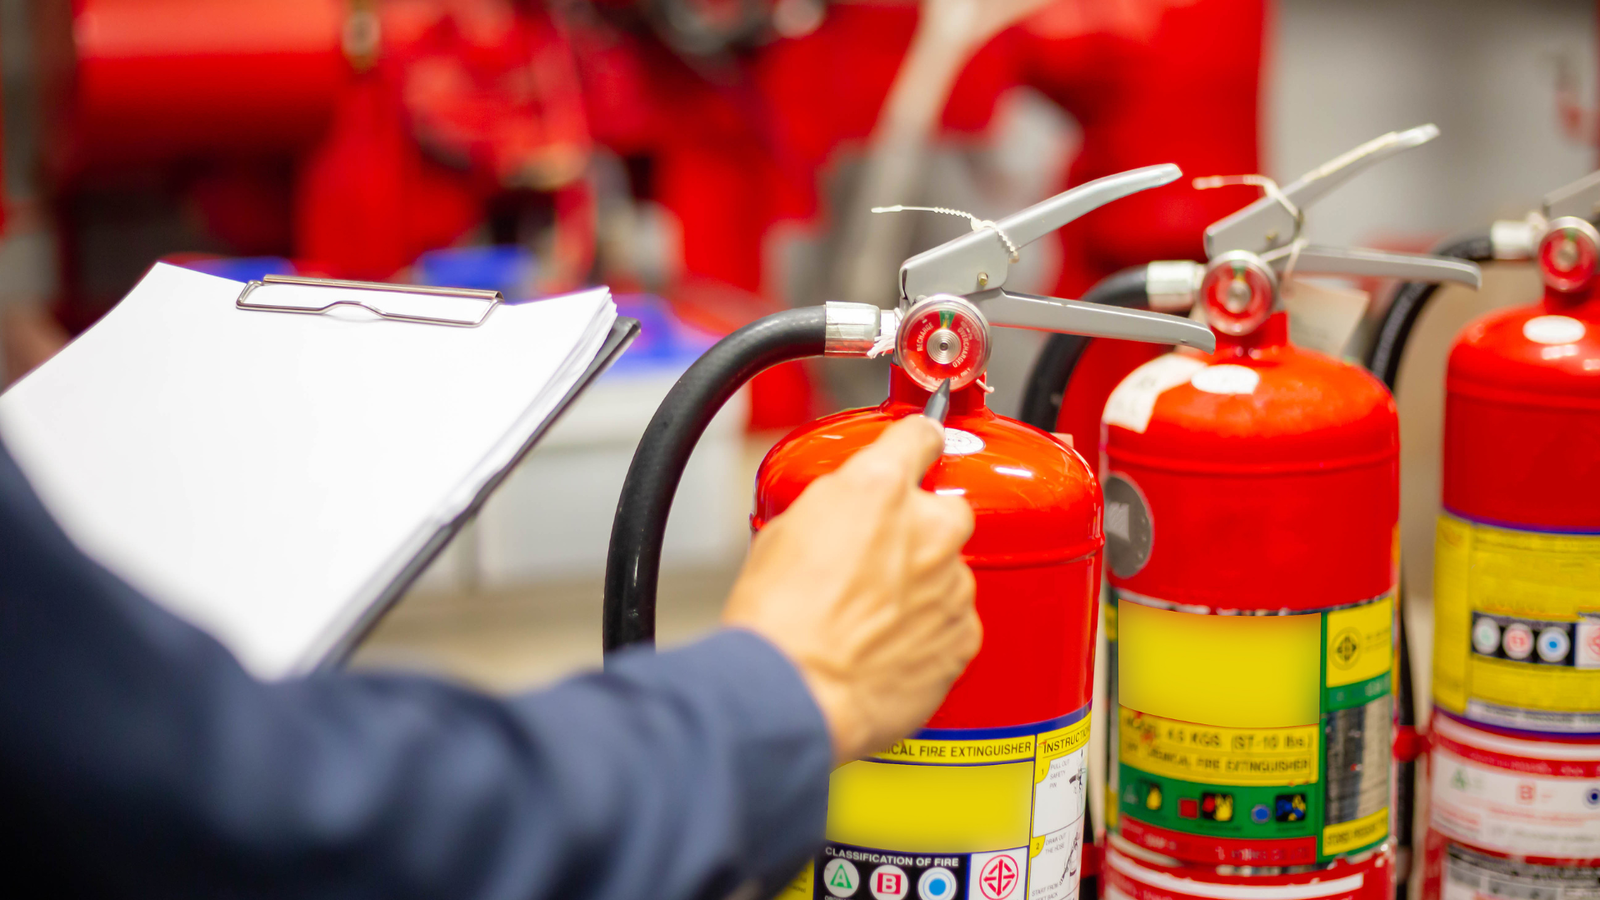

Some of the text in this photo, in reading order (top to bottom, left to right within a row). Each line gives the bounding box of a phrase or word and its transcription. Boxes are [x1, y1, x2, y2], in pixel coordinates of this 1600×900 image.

[919, 745, 946, 757] FIRE
[950, 741, 1032, 758] EXTINGUISHER
[825, 846, 959, 867] CLASSIFICATION OF FIRE
